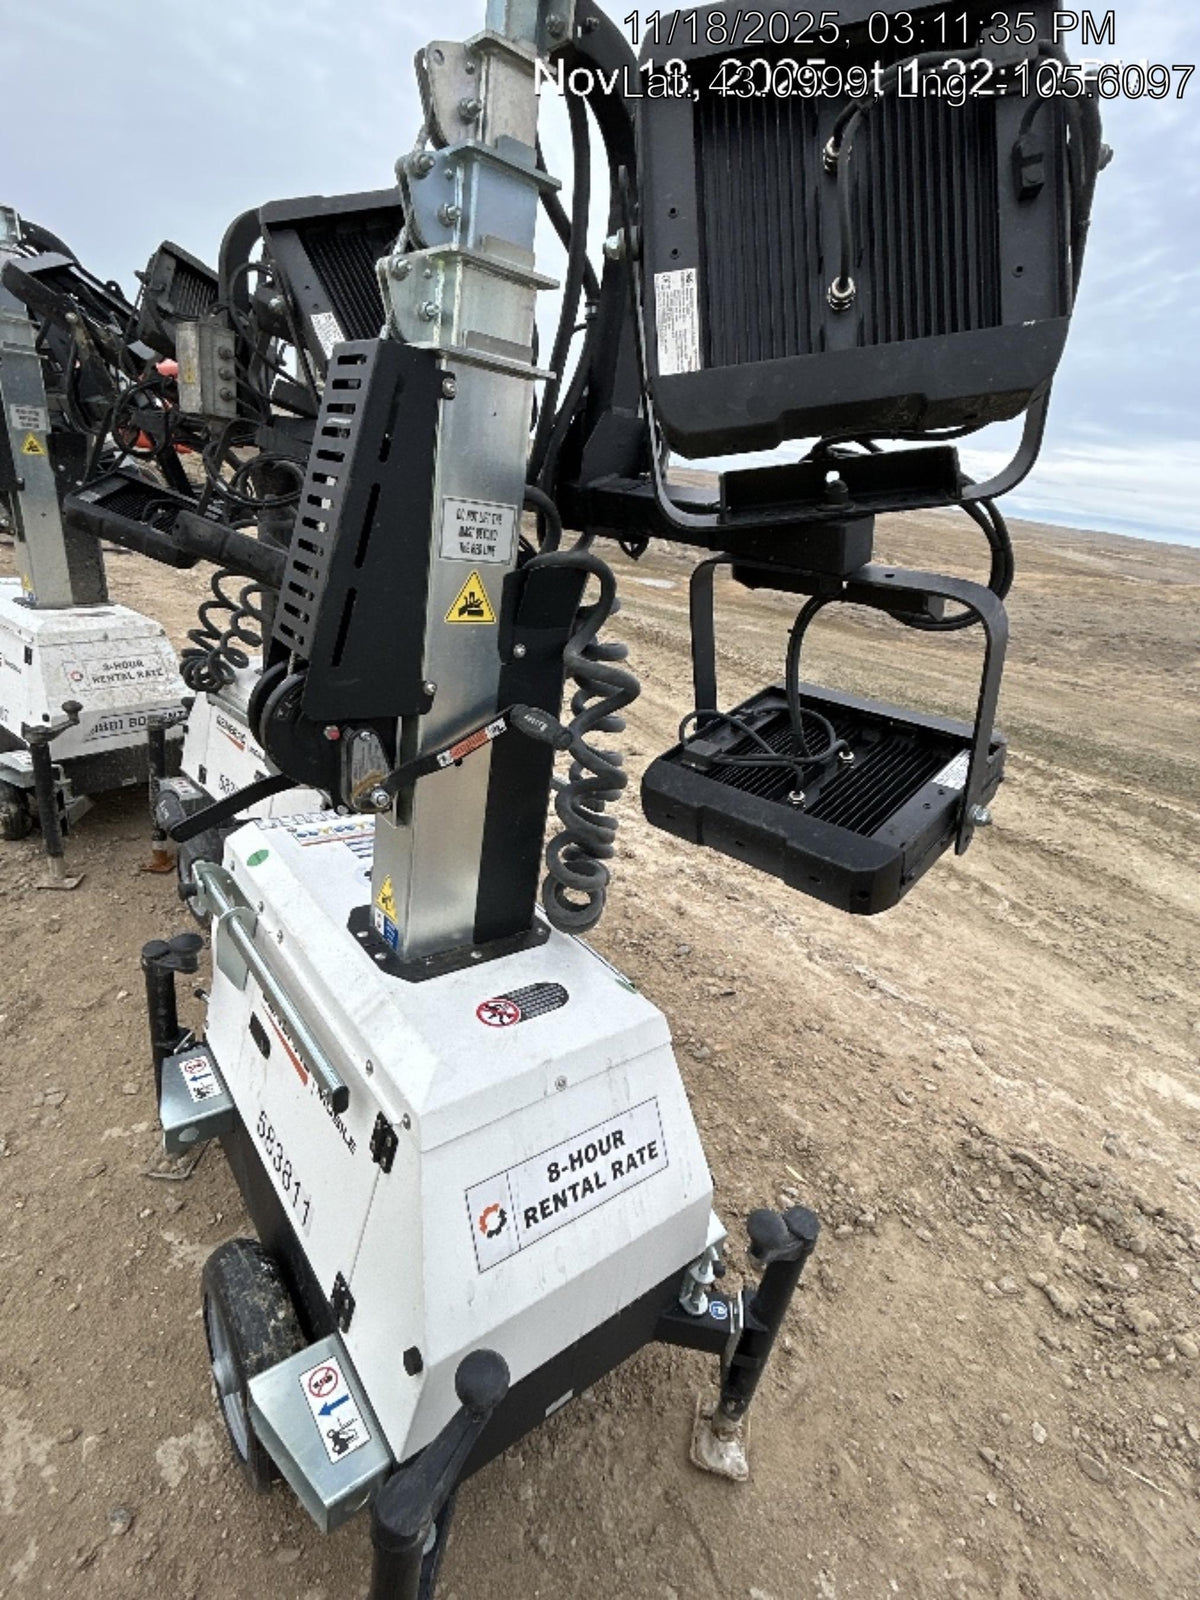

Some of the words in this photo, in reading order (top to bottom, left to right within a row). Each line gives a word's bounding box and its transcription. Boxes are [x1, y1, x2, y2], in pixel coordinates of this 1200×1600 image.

[256, 1110, 310, 1227] 583811
[523, 1171, 607, 1229] RENTAL
[611, 1140, 659, 1181] RATE
[547, 1129, 626, 1183] 8-HOUR
